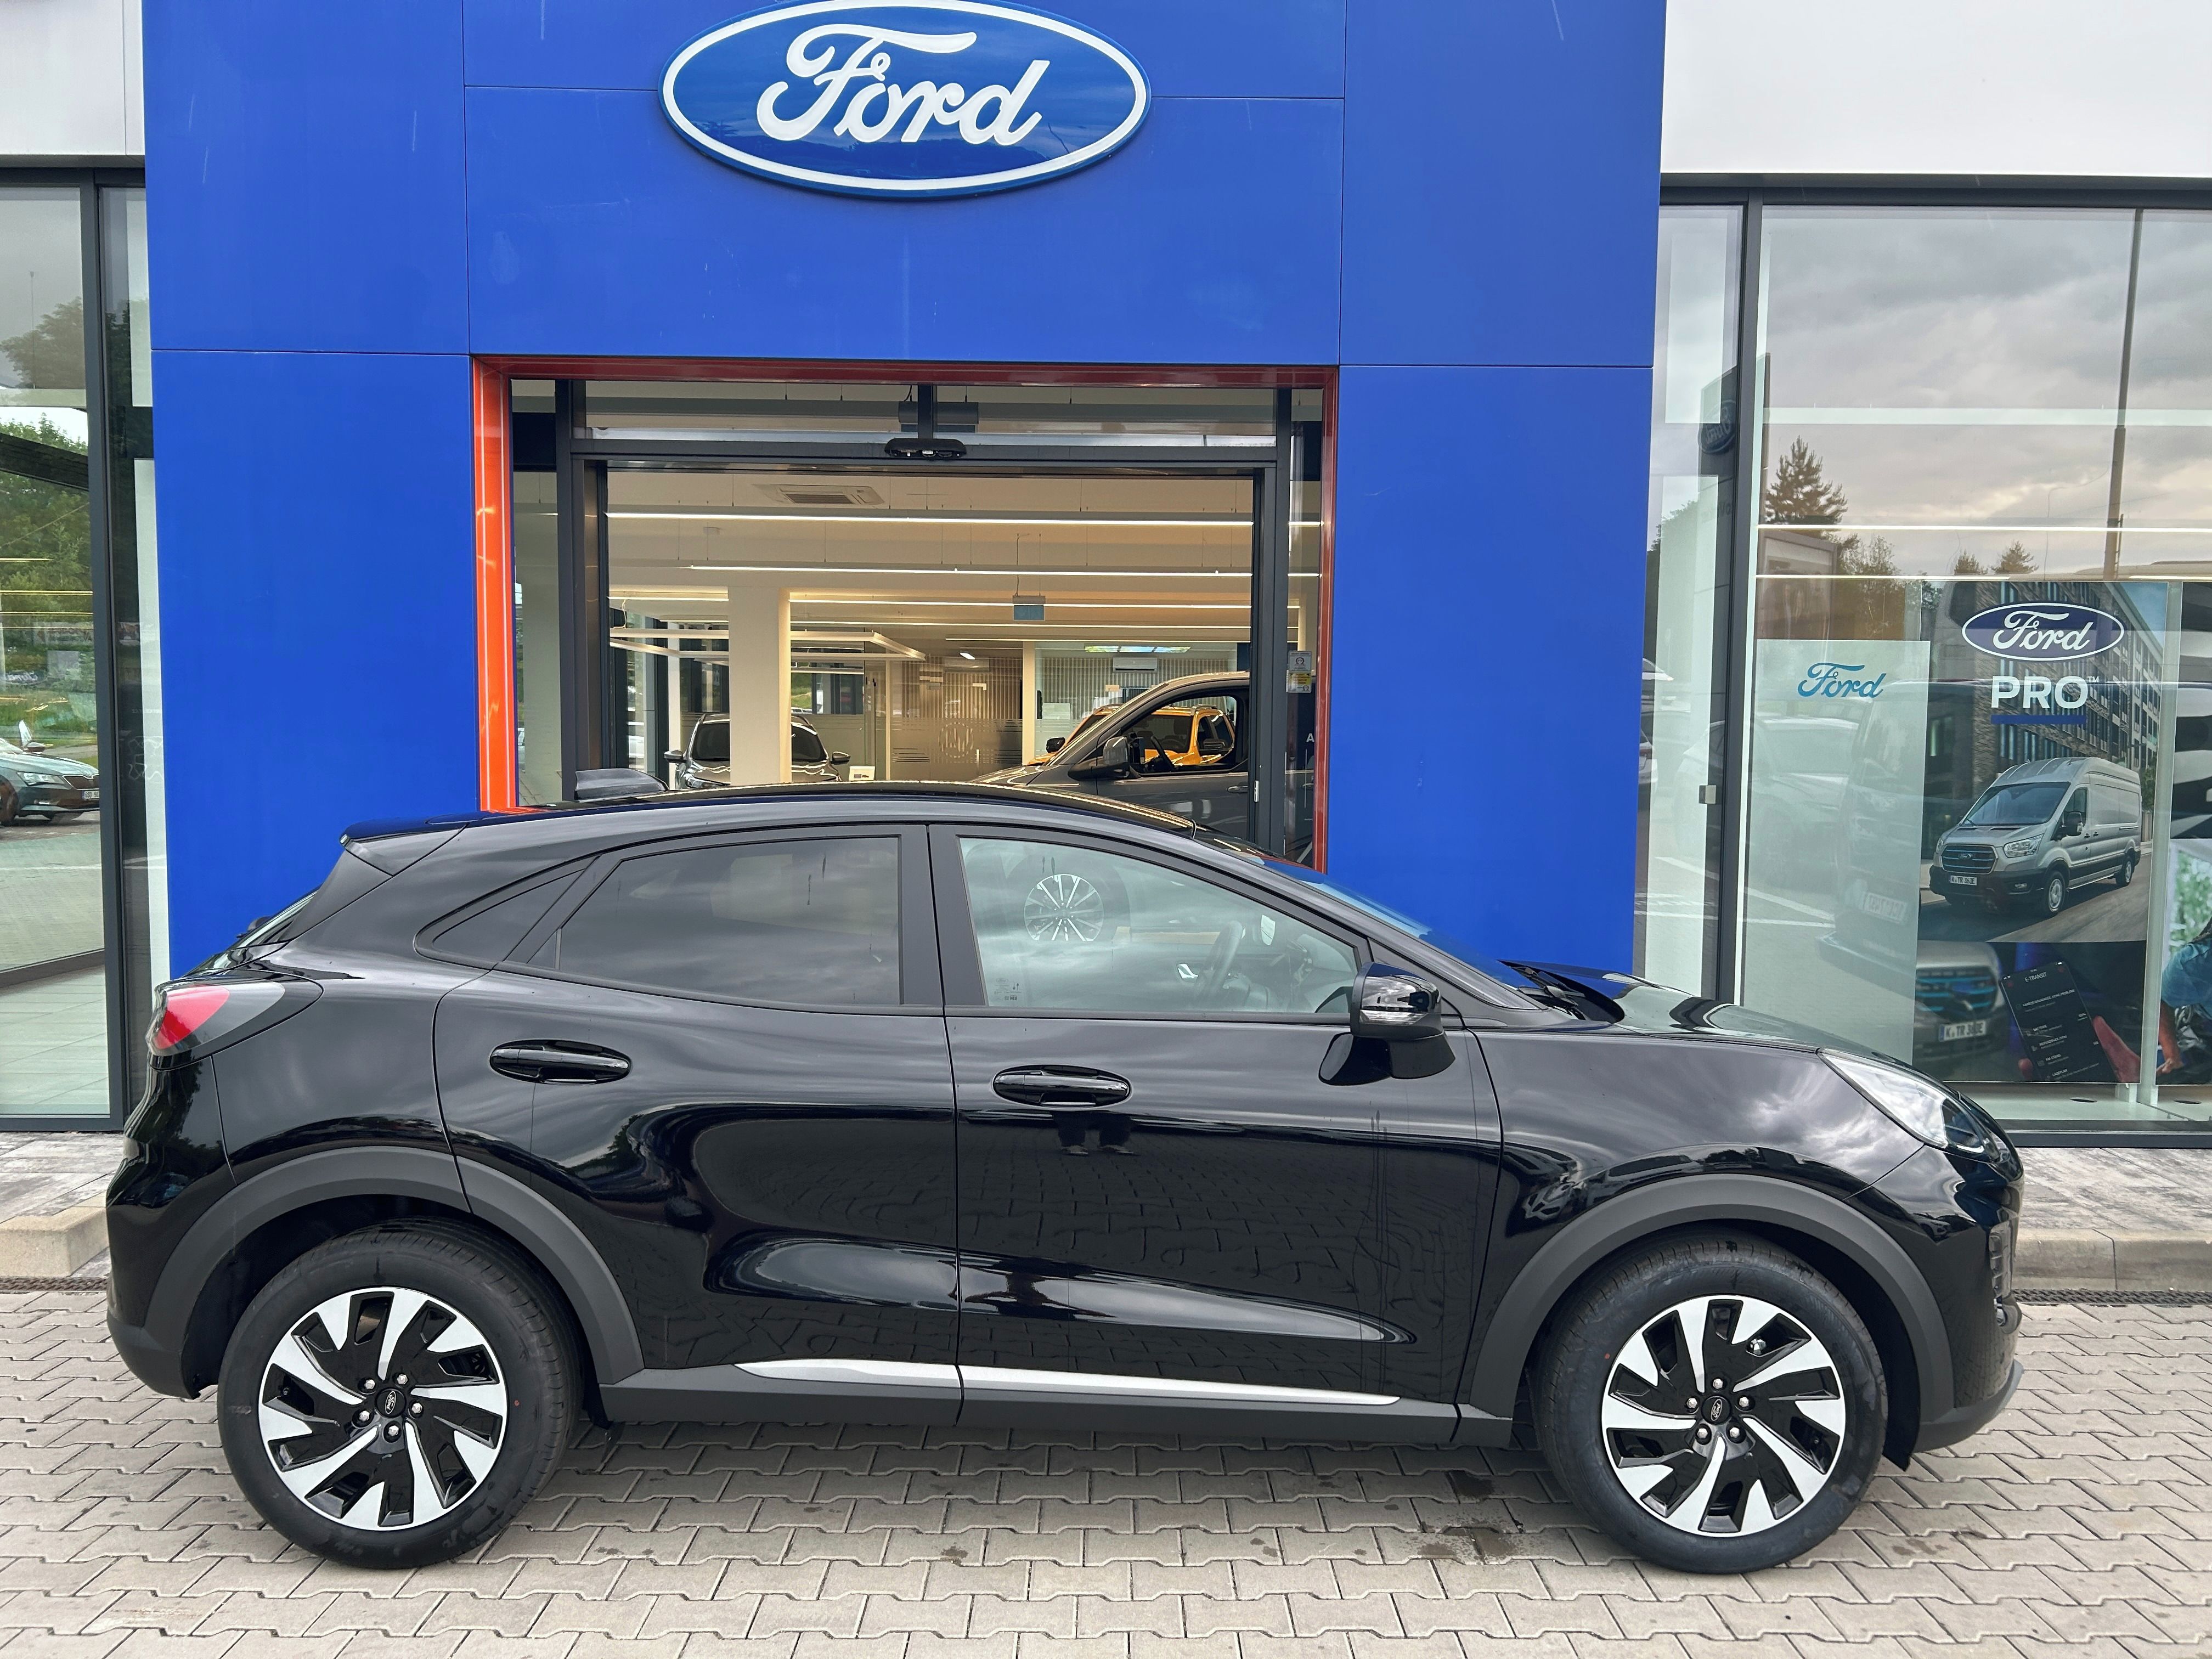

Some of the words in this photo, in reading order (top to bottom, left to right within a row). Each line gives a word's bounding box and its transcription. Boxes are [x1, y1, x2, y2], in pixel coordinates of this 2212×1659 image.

[757, 24, 1050, 145] Ford
[1993, 611, 2094, 650] Ford
[1798, 663, 1887, 698] Ford
[1991, 676, 2089, 709] PRO
